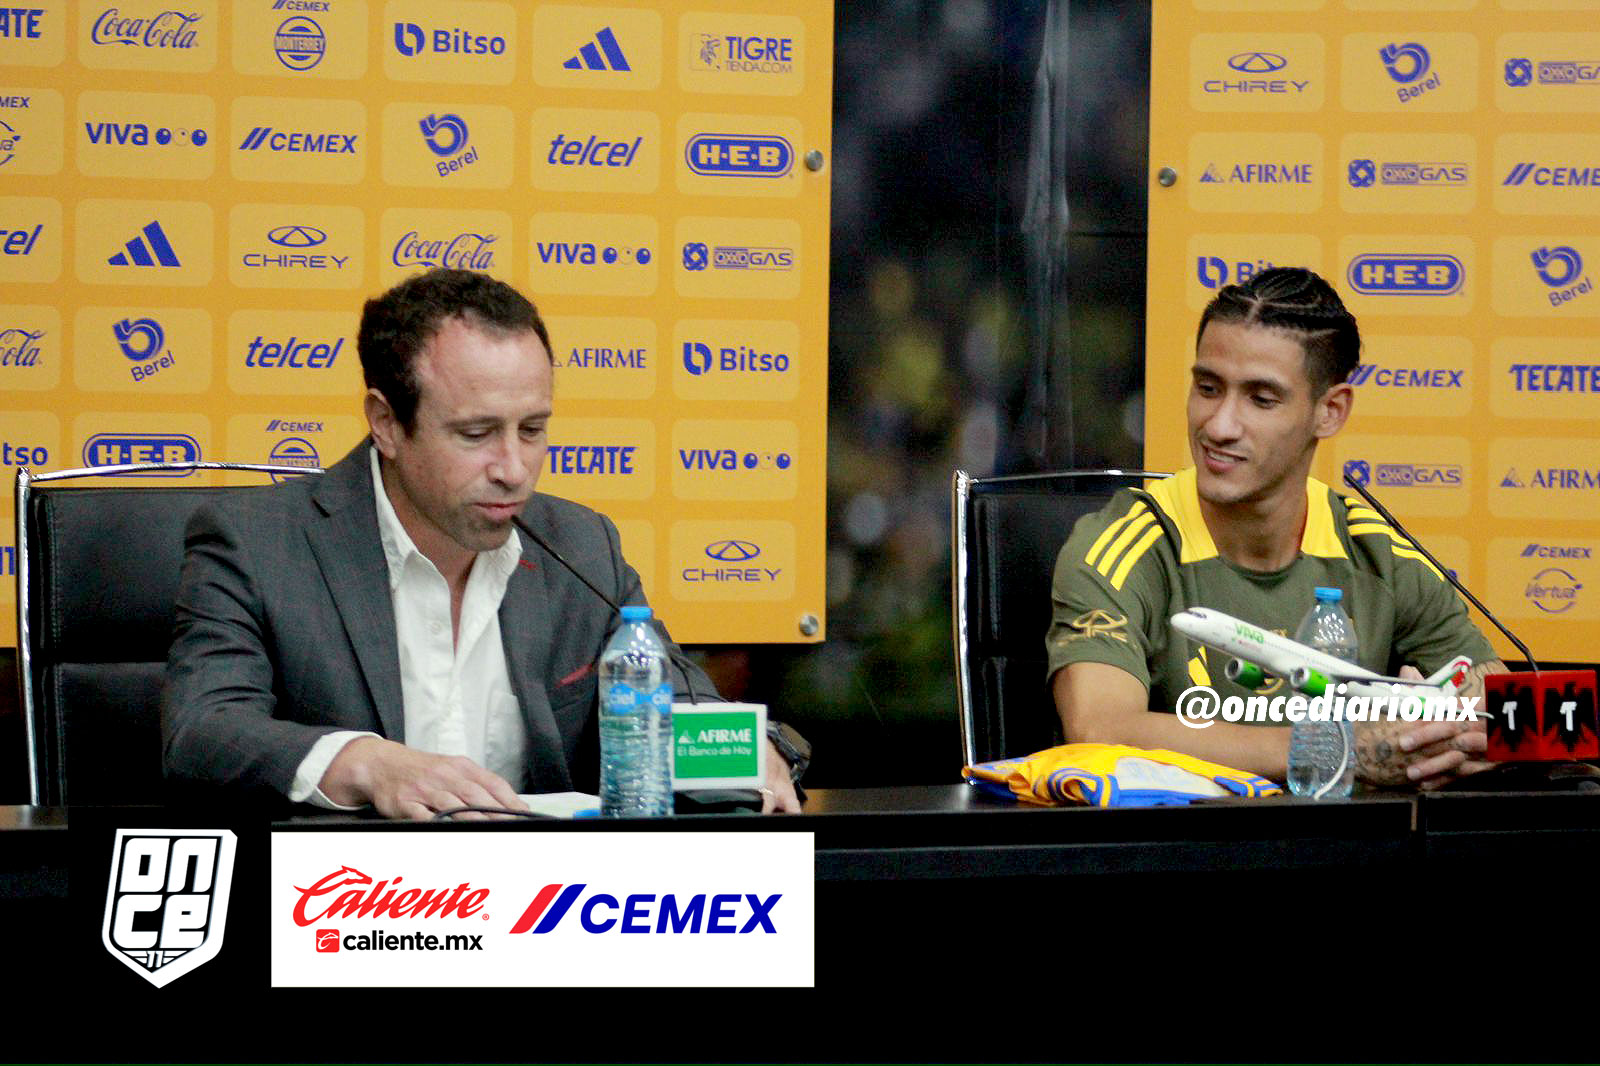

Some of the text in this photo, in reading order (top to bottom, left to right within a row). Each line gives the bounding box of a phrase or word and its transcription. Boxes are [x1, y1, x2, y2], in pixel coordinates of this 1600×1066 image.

[287, 1, 330, 12] CEMEX
[91, 8, 201, 49] Coca-Cola
[432, 28, 506, 56] Bitso
[725, 36, 792, 61] TIGRE
[1203, 80, 1309, 93] CHIREY
[1396, 71, 1441, 103] Berel
[270, 132, 357, 154] CEMEX
[547, 134, 643, 168] telcel
[436, 146, 479, 178] Berel
[1230, 163, 1313, 184] AFIRME
[243, 254, 348, 269] CHIREY
[391, 231, 497, 271] Coca-Cola
[1549, 276, 1593, 307] Berel
[245, 336, 345, 369] telcel
[567, 348, 647, 369] AFIRME
[720, 346, 790, 372] Bitso
[130, 350, 176, 382] Berel
[1375, 369, 1464, 388] CEMEX
[280, 422, 324, 432] CEMEX
[547, 445, 638, 474] TECATE
[1538, 546, 1592, 558] CEMEX
[682, 568, 782, 582] CHIREY
[697, 729, 752, 743] AFIRME
